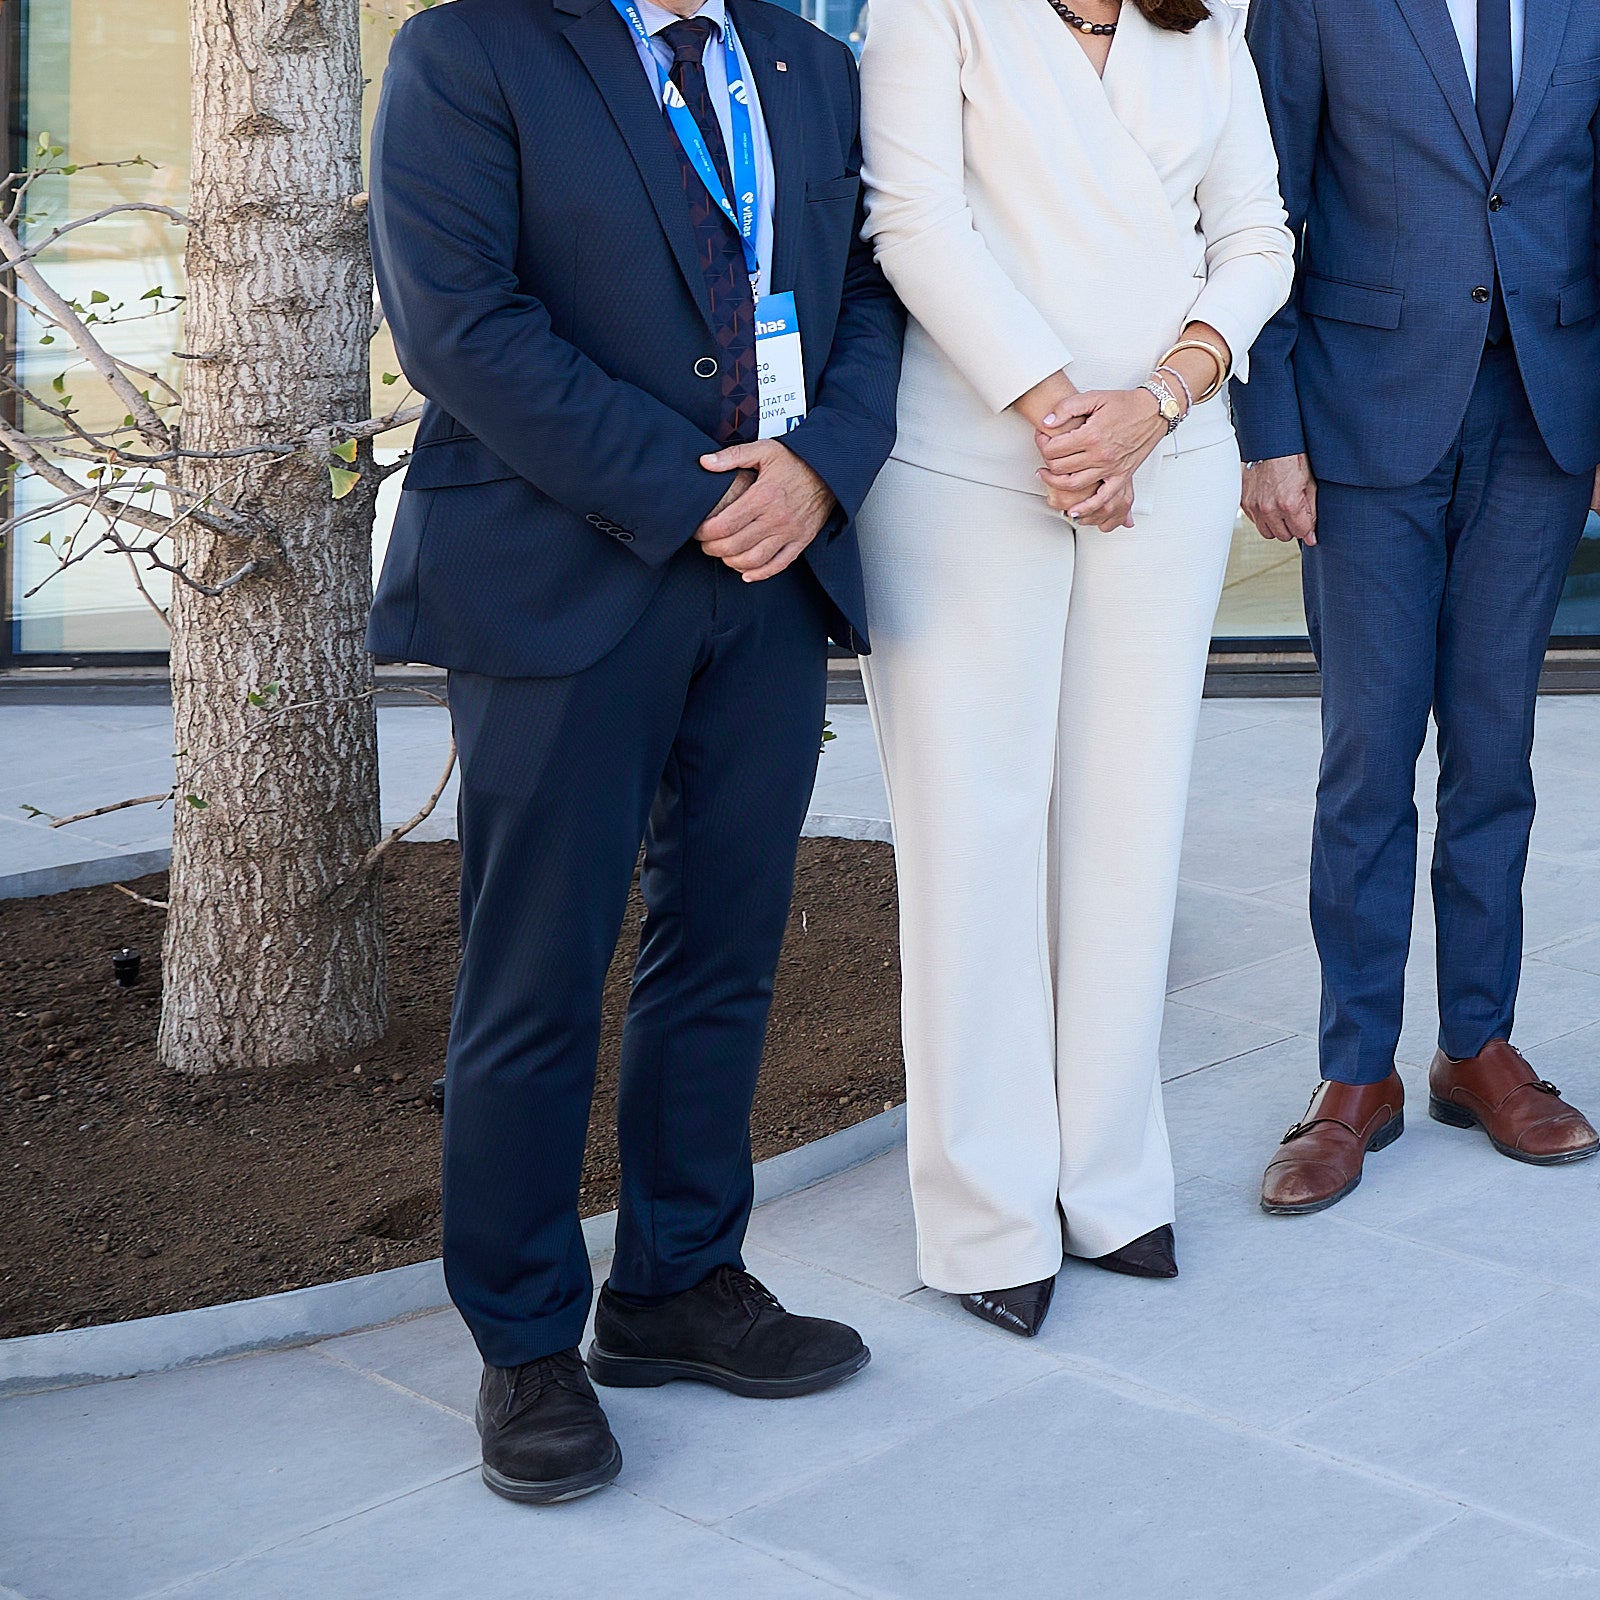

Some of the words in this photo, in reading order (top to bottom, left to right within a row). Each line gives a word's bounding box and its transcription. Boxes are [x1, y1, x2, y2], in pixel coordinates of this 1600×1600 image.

[742, 205, 751, 238] vithas
[755, 319, 787, 336] has
[784, 391, 797, 402] DE
[761, 407, 787, 420] UNYA
